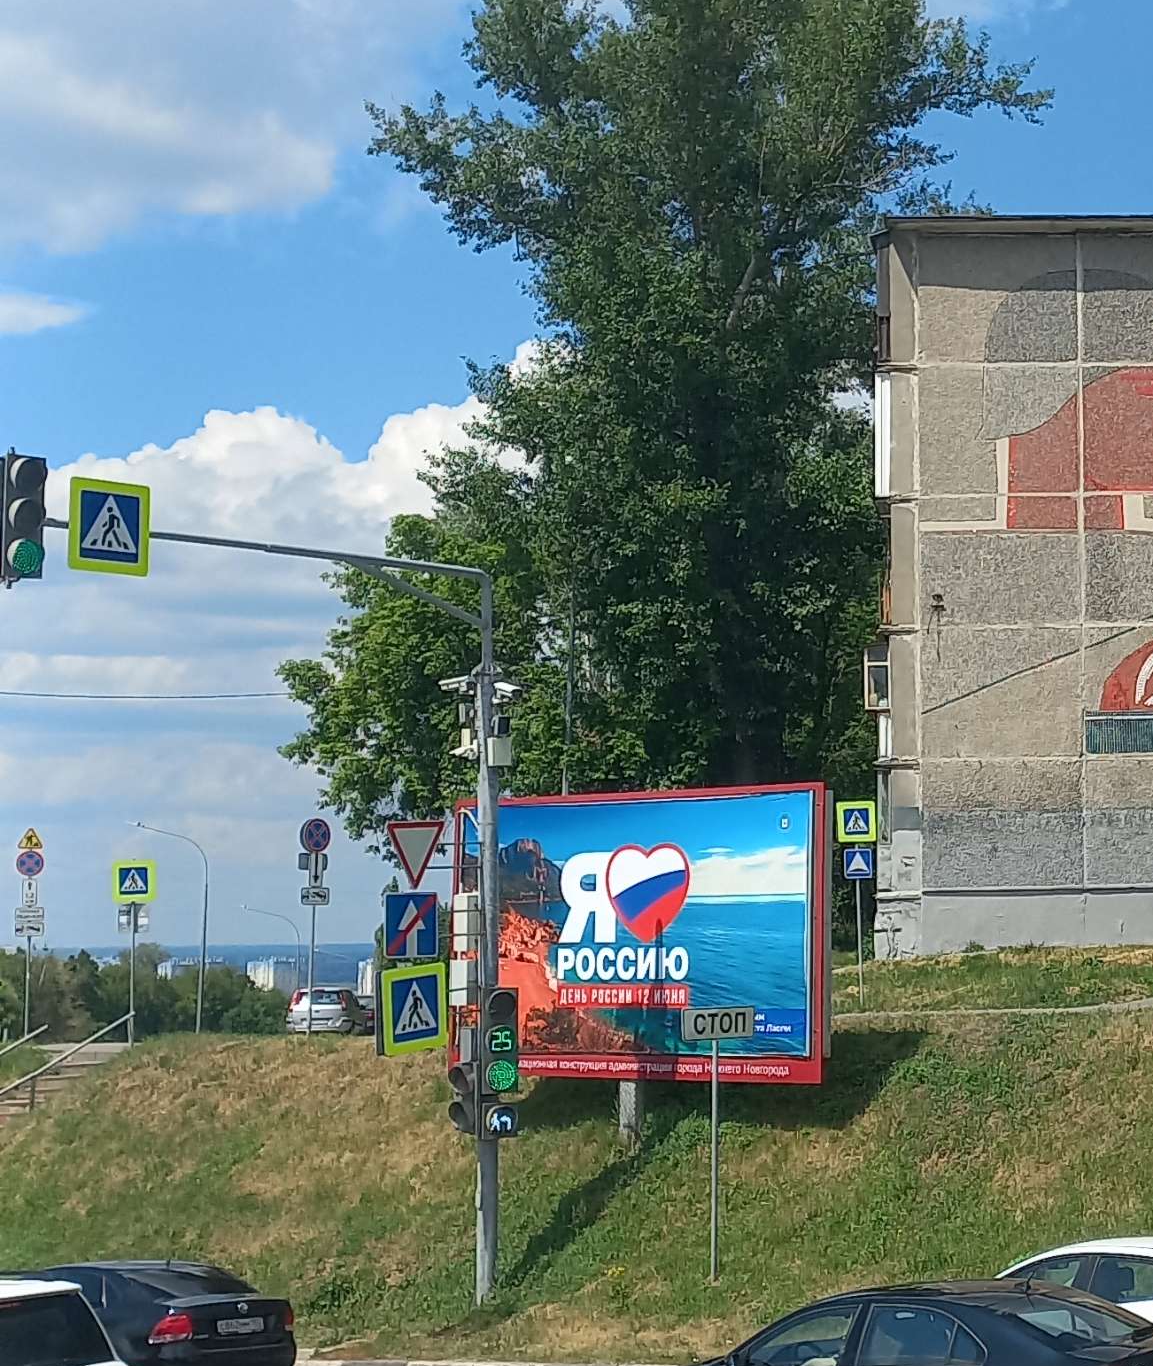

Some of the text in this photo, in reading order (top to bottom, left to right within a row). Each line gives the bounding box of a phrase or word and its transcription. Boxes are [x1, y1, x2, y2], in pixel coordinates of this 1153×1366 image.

[558, 852, 617, 944] Я
[557, 946, 689, 981] РОССИЮ
[560, 988, 686, 1005] ДЕНЬ РОССИИ 12 ИЮНЯ
[693, 1012, 747, 1035] СТОП
[491, 1030, 512, 1051] 25
